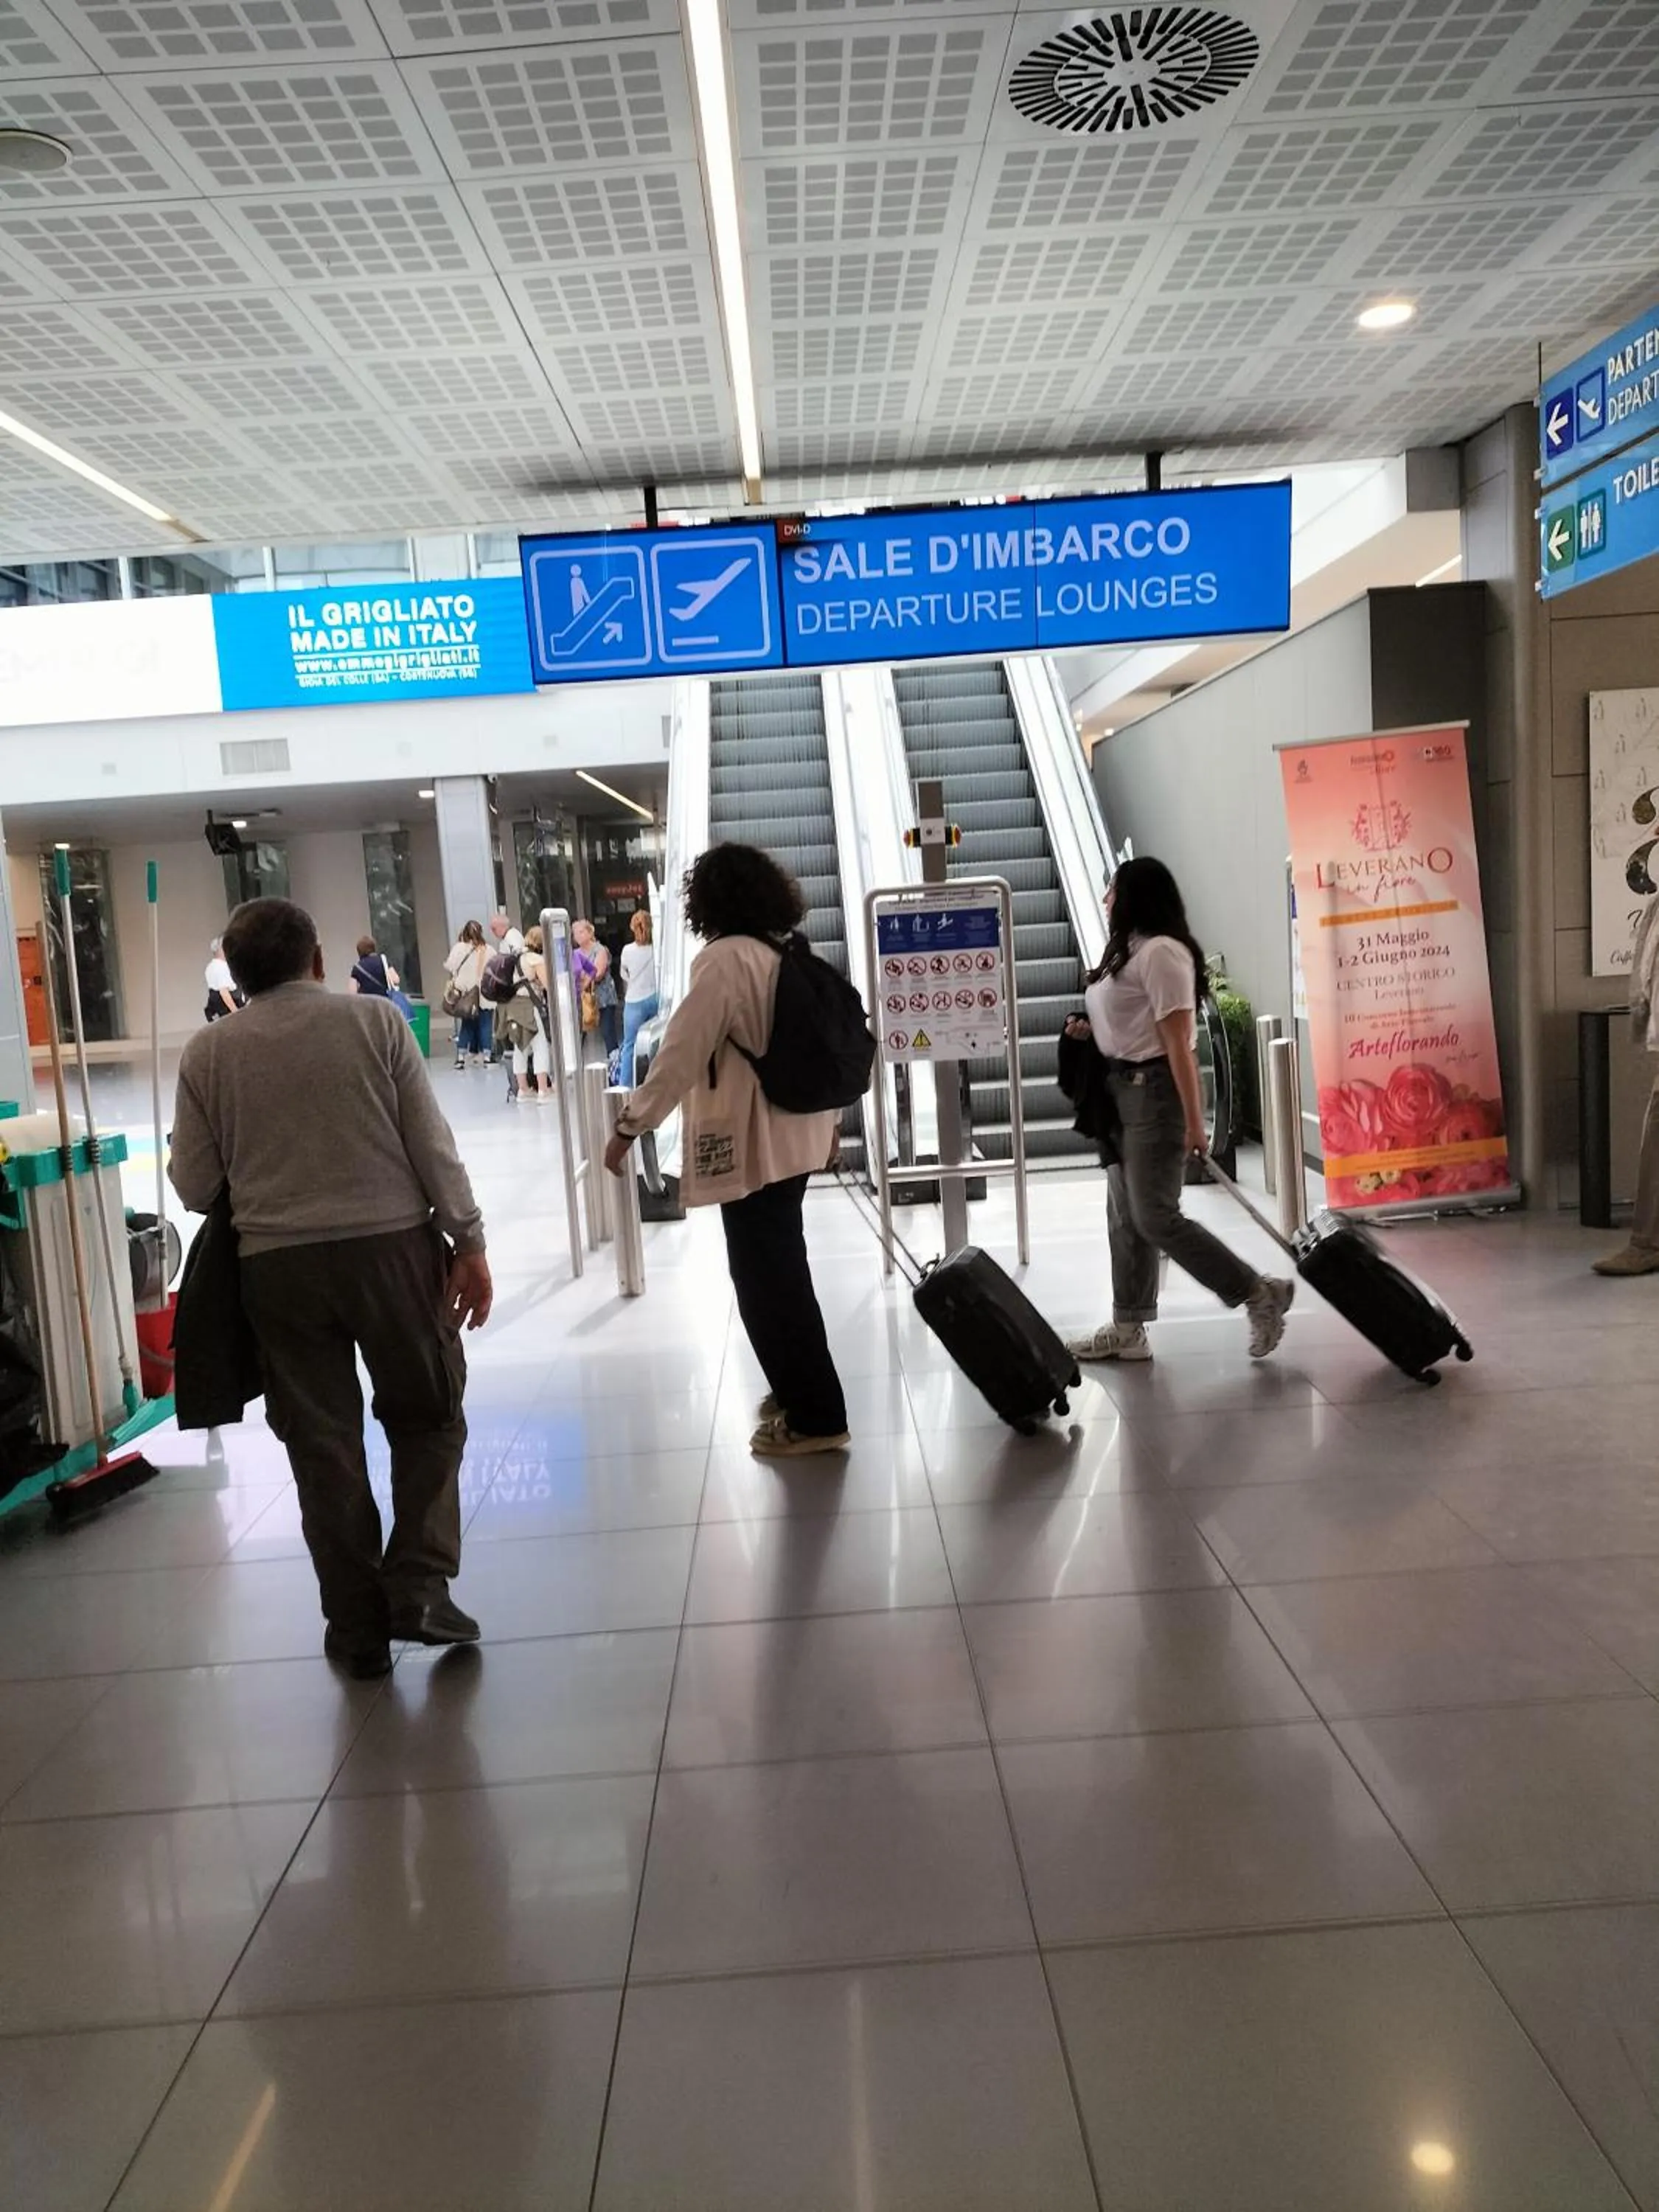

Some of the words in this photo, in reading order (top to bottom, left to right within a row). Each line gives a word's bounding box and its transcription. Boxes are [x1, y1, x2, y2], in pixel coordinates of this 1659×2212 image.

[1607, 369, 1659, 425] DEPART
[784, 523, 811, 536] DVI-D
[793, 538, 914, 583] SALE
[928, 517, 1191, 574] D'IMBARCO
[288, 603, 315, 629] IL
[321, 594, 474, 626] GRIGLIATO
[797, 588, 1023, 635] DEPARTURE
[1037, 571, 1217, 617] LOUNGES
[290, 627, 367, 653] MADE
[373, 625, 402, 647] IN
[407, 620, 477, 646] ITALY
[1357, 936, 1371, 951] 31
[1376, 928, 1430, 947] Maggio
[1362, 948, 1416, 965] Giugno
[1420, 945, 1450, 958] 2024
[1349, 1023, 1460, 1060] Arteflorando
